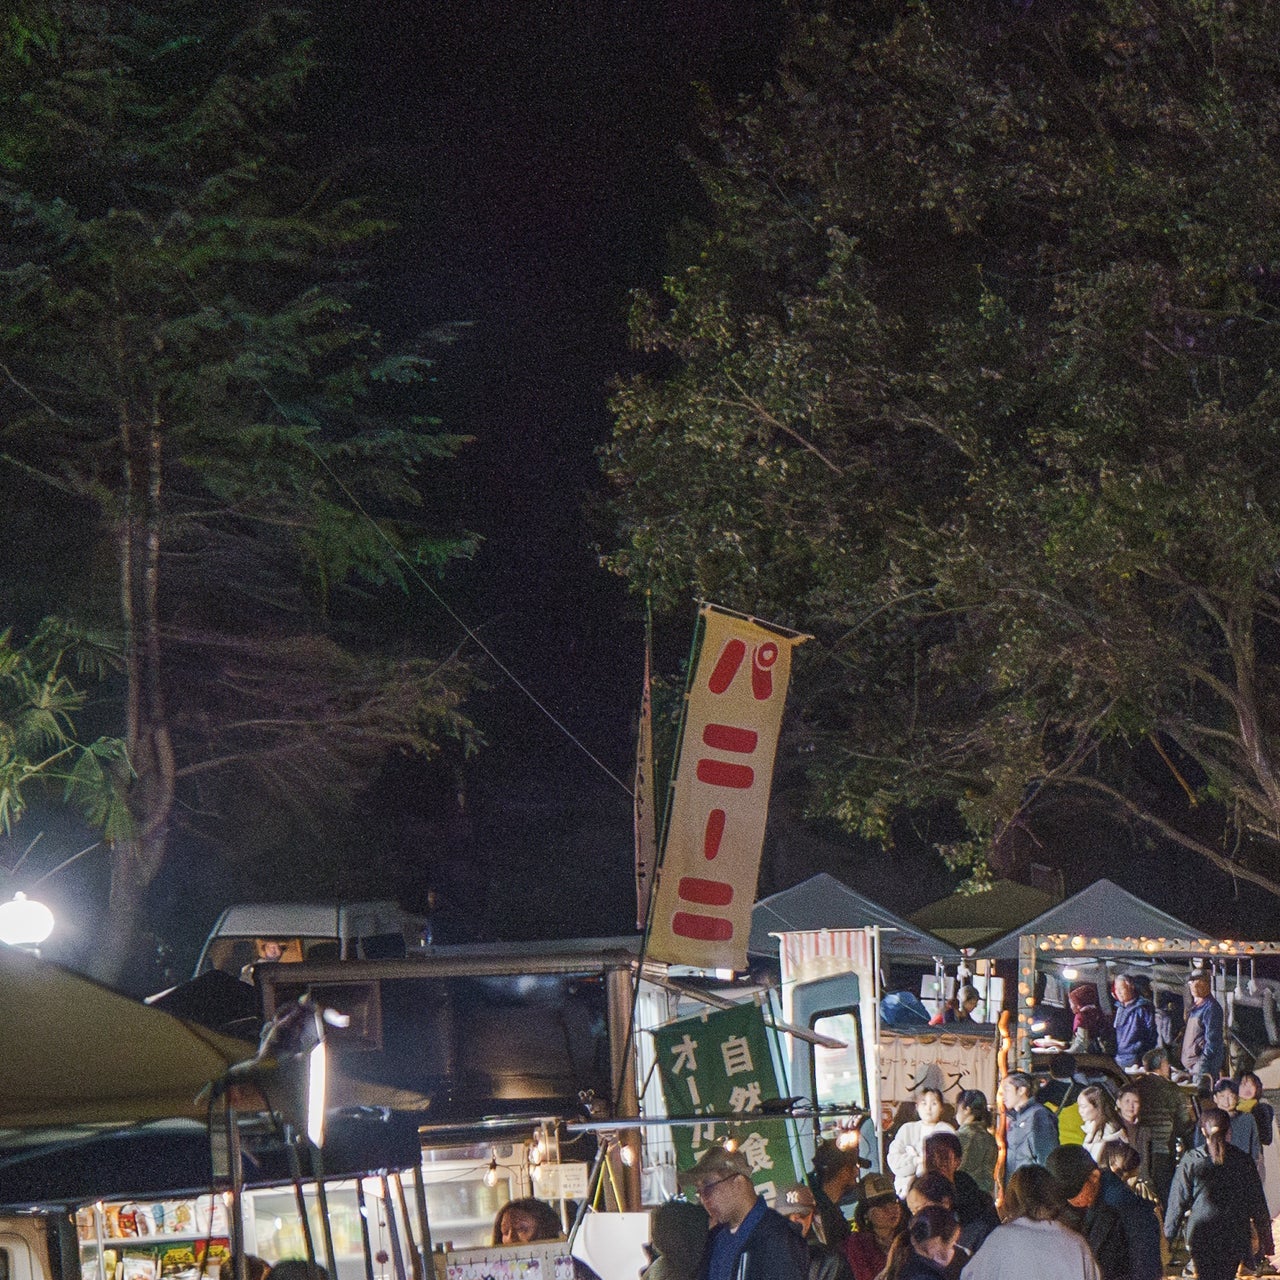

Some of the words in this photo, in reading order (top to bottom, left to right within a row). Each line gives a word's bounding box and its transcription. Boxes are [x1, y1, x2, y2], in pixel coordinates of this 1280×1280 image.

[672, 639, 778, 941] パニーニ
[671, 1034, 715, 1165] オーガ
